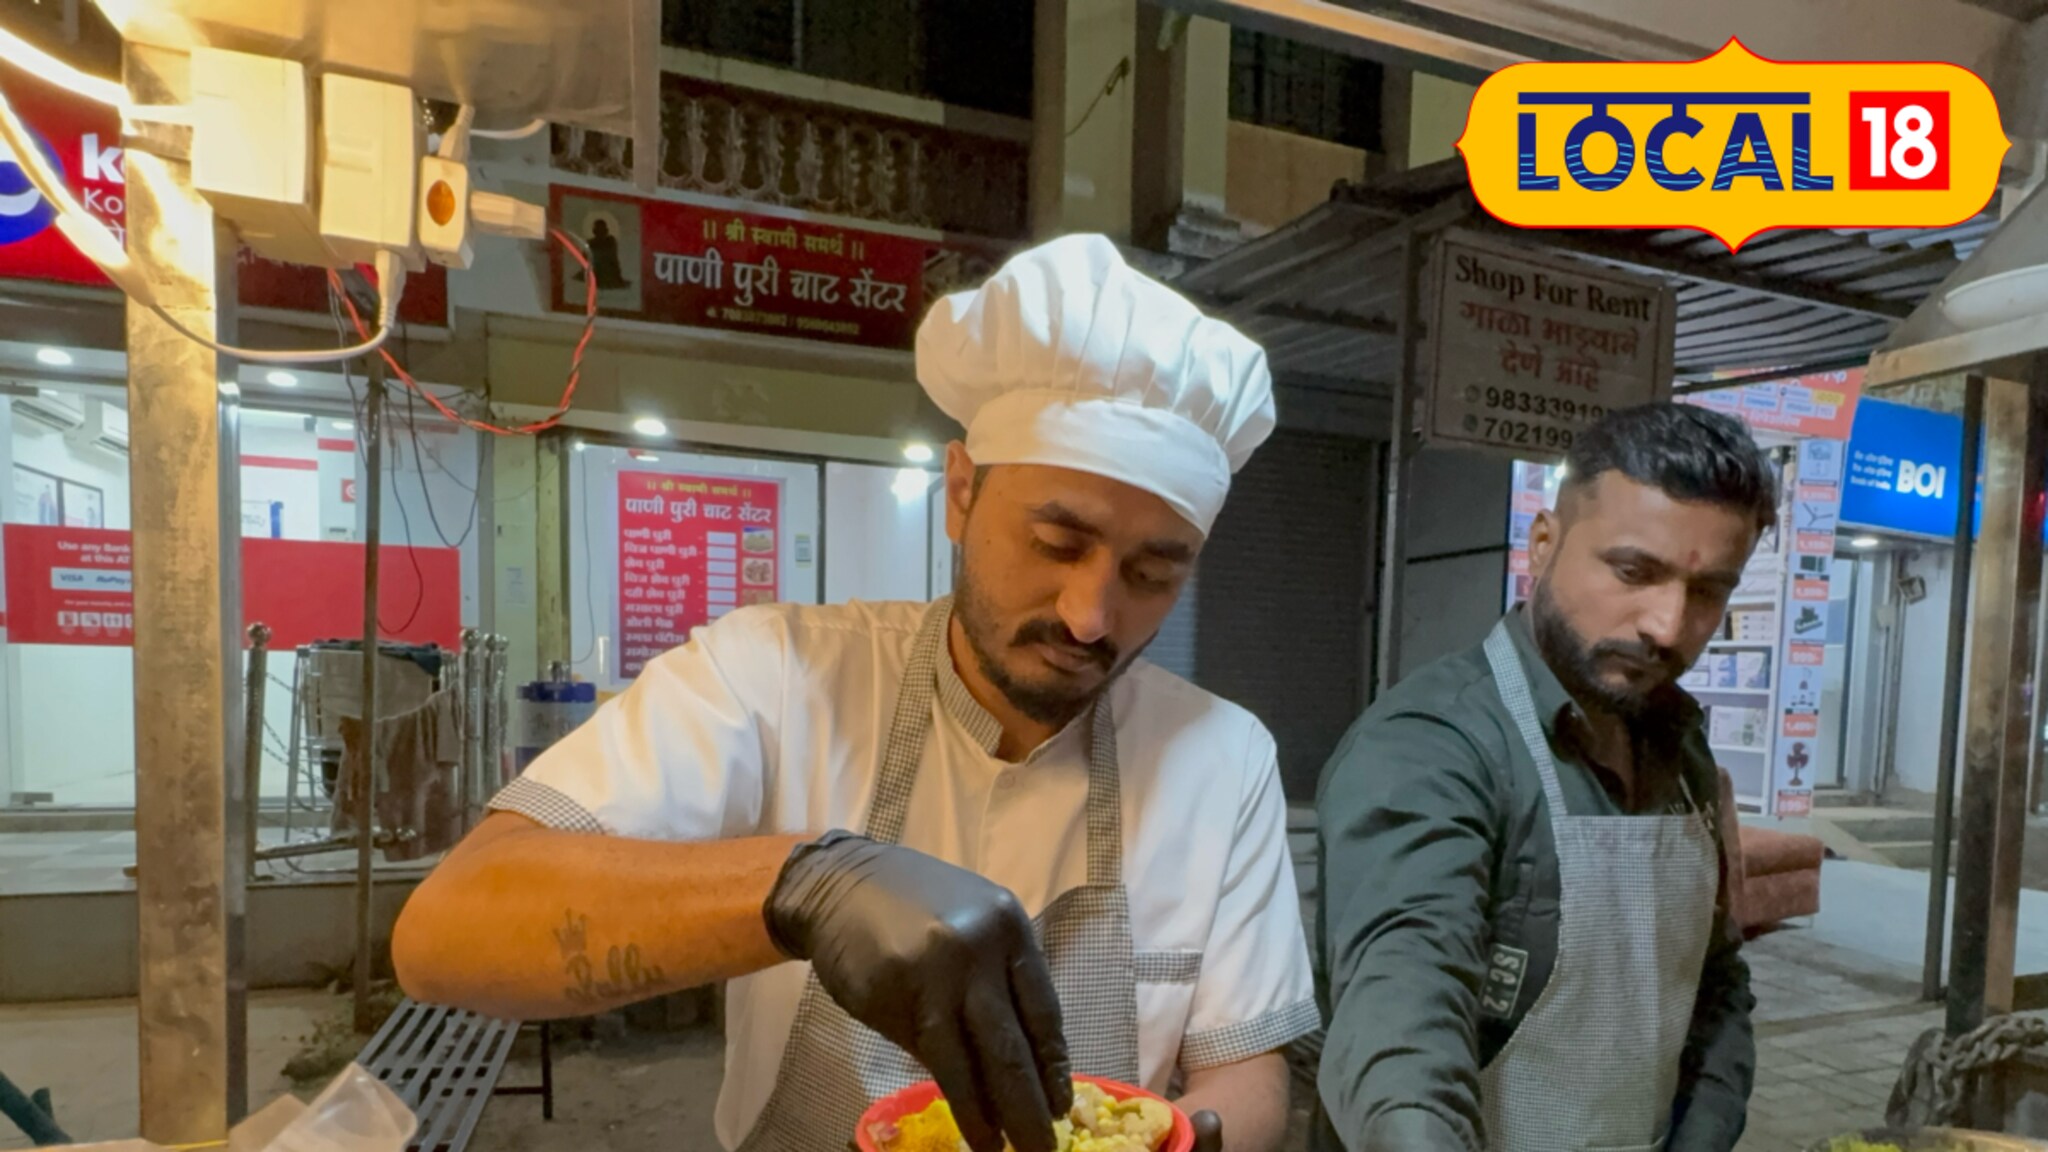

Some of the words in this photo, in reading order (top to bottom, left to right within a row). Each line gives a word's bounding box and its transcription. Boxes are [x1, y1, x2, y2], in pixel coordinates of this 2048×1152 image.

[83, 187, 126, 214] Ko
[653, 247, 723, 290] पाणी
[733, 255, 780, 306] पुरी
[790, 269, 841, 303] चाट
[849, 267, 907, 312] सेंटर
[1455, 254, 1525, 301] Shop
[1533, 273, 1579, 306] For
[1587, 285, 1652, 321] Rent
[1484, 417, 1574, 450] 702199
[1896, 459, 1946, 499] BOI
[625, 494, 664, 515] पाणी
[670, 496, 697, 523] पुरी
[703, 502, 732, 520] चाट
